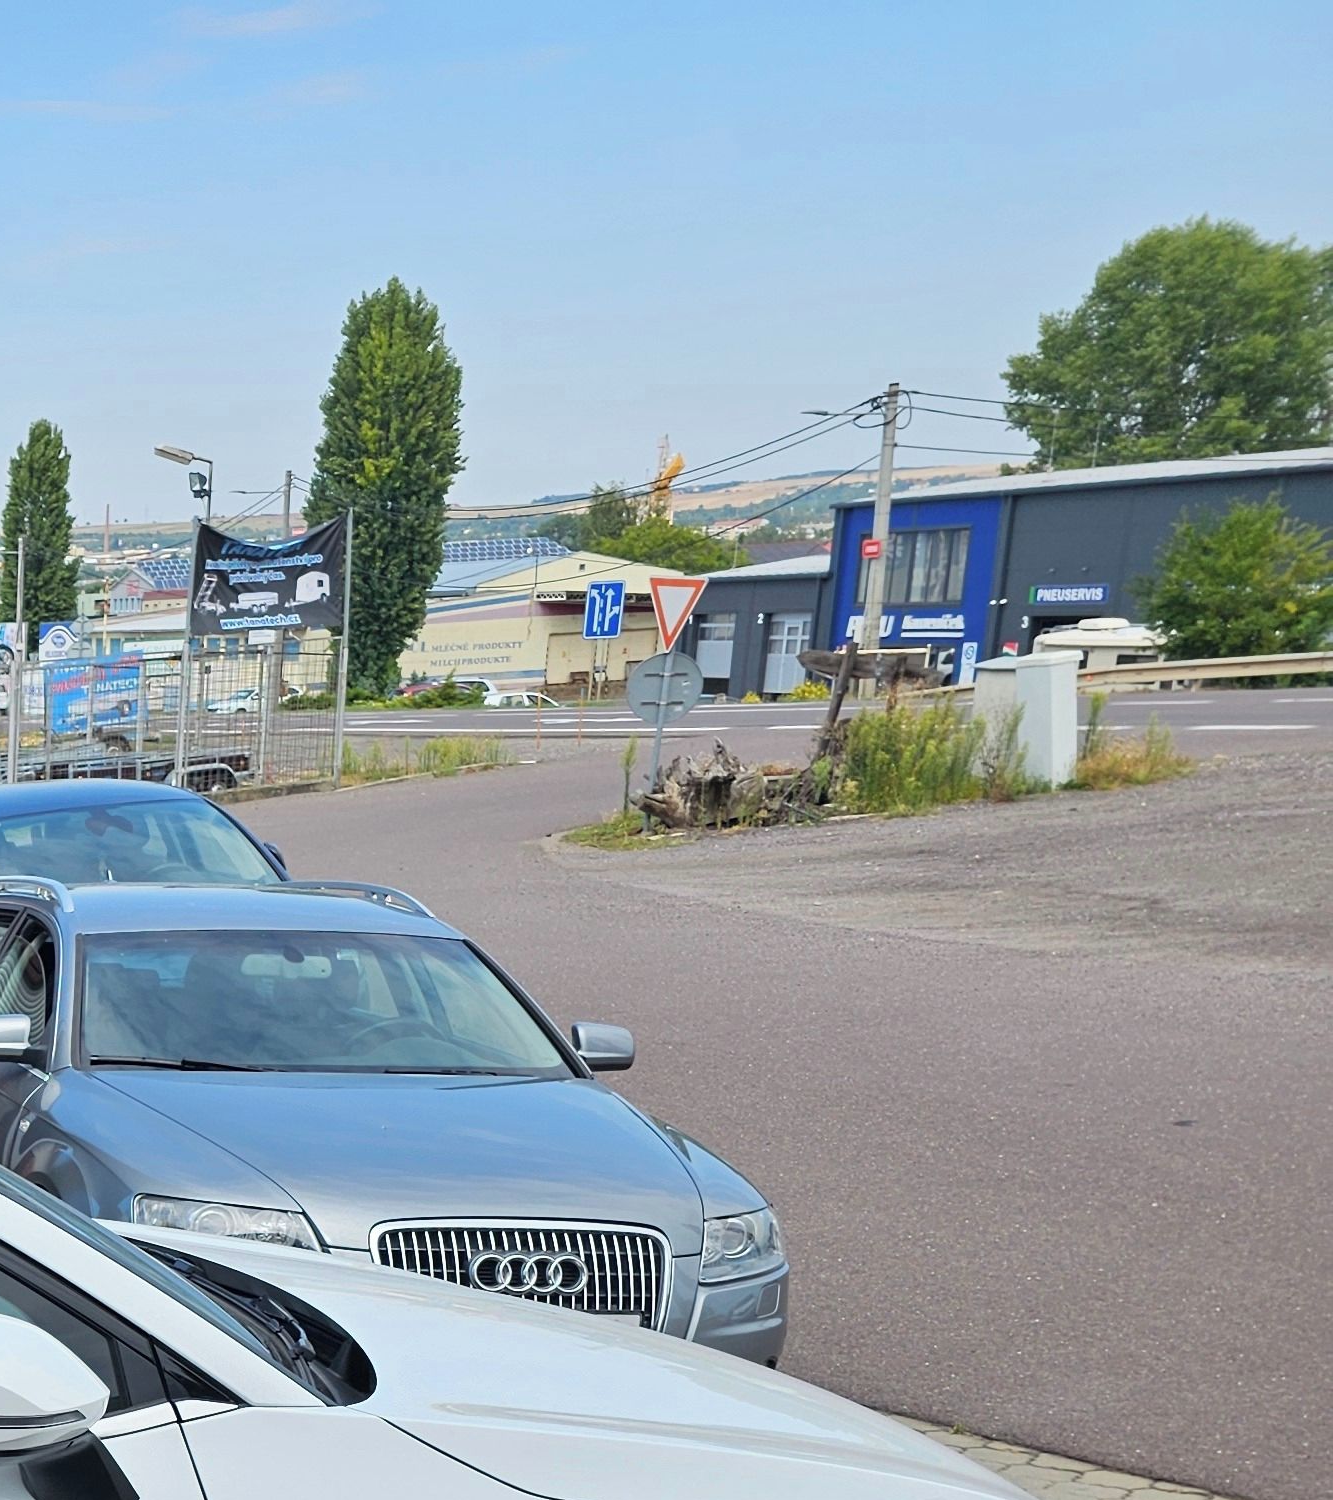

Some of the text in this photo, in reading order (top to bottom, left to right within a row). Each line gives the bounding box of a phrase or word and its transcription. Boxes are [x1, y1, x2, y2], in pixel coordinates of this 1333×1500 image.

[1036, 587, 1103, 601] PNEUSERVIS
[220, 614, 301, 629] www.tanatech.cz
[757, 612, 764, 624] 2
[1021, 615, 1029, 629] 3
[472, 641, 524, 651] PRODUKTY
[430, 655, 512, 667] MILCHPRODUKTE
[81, 677, 139, 694] TNATEC
